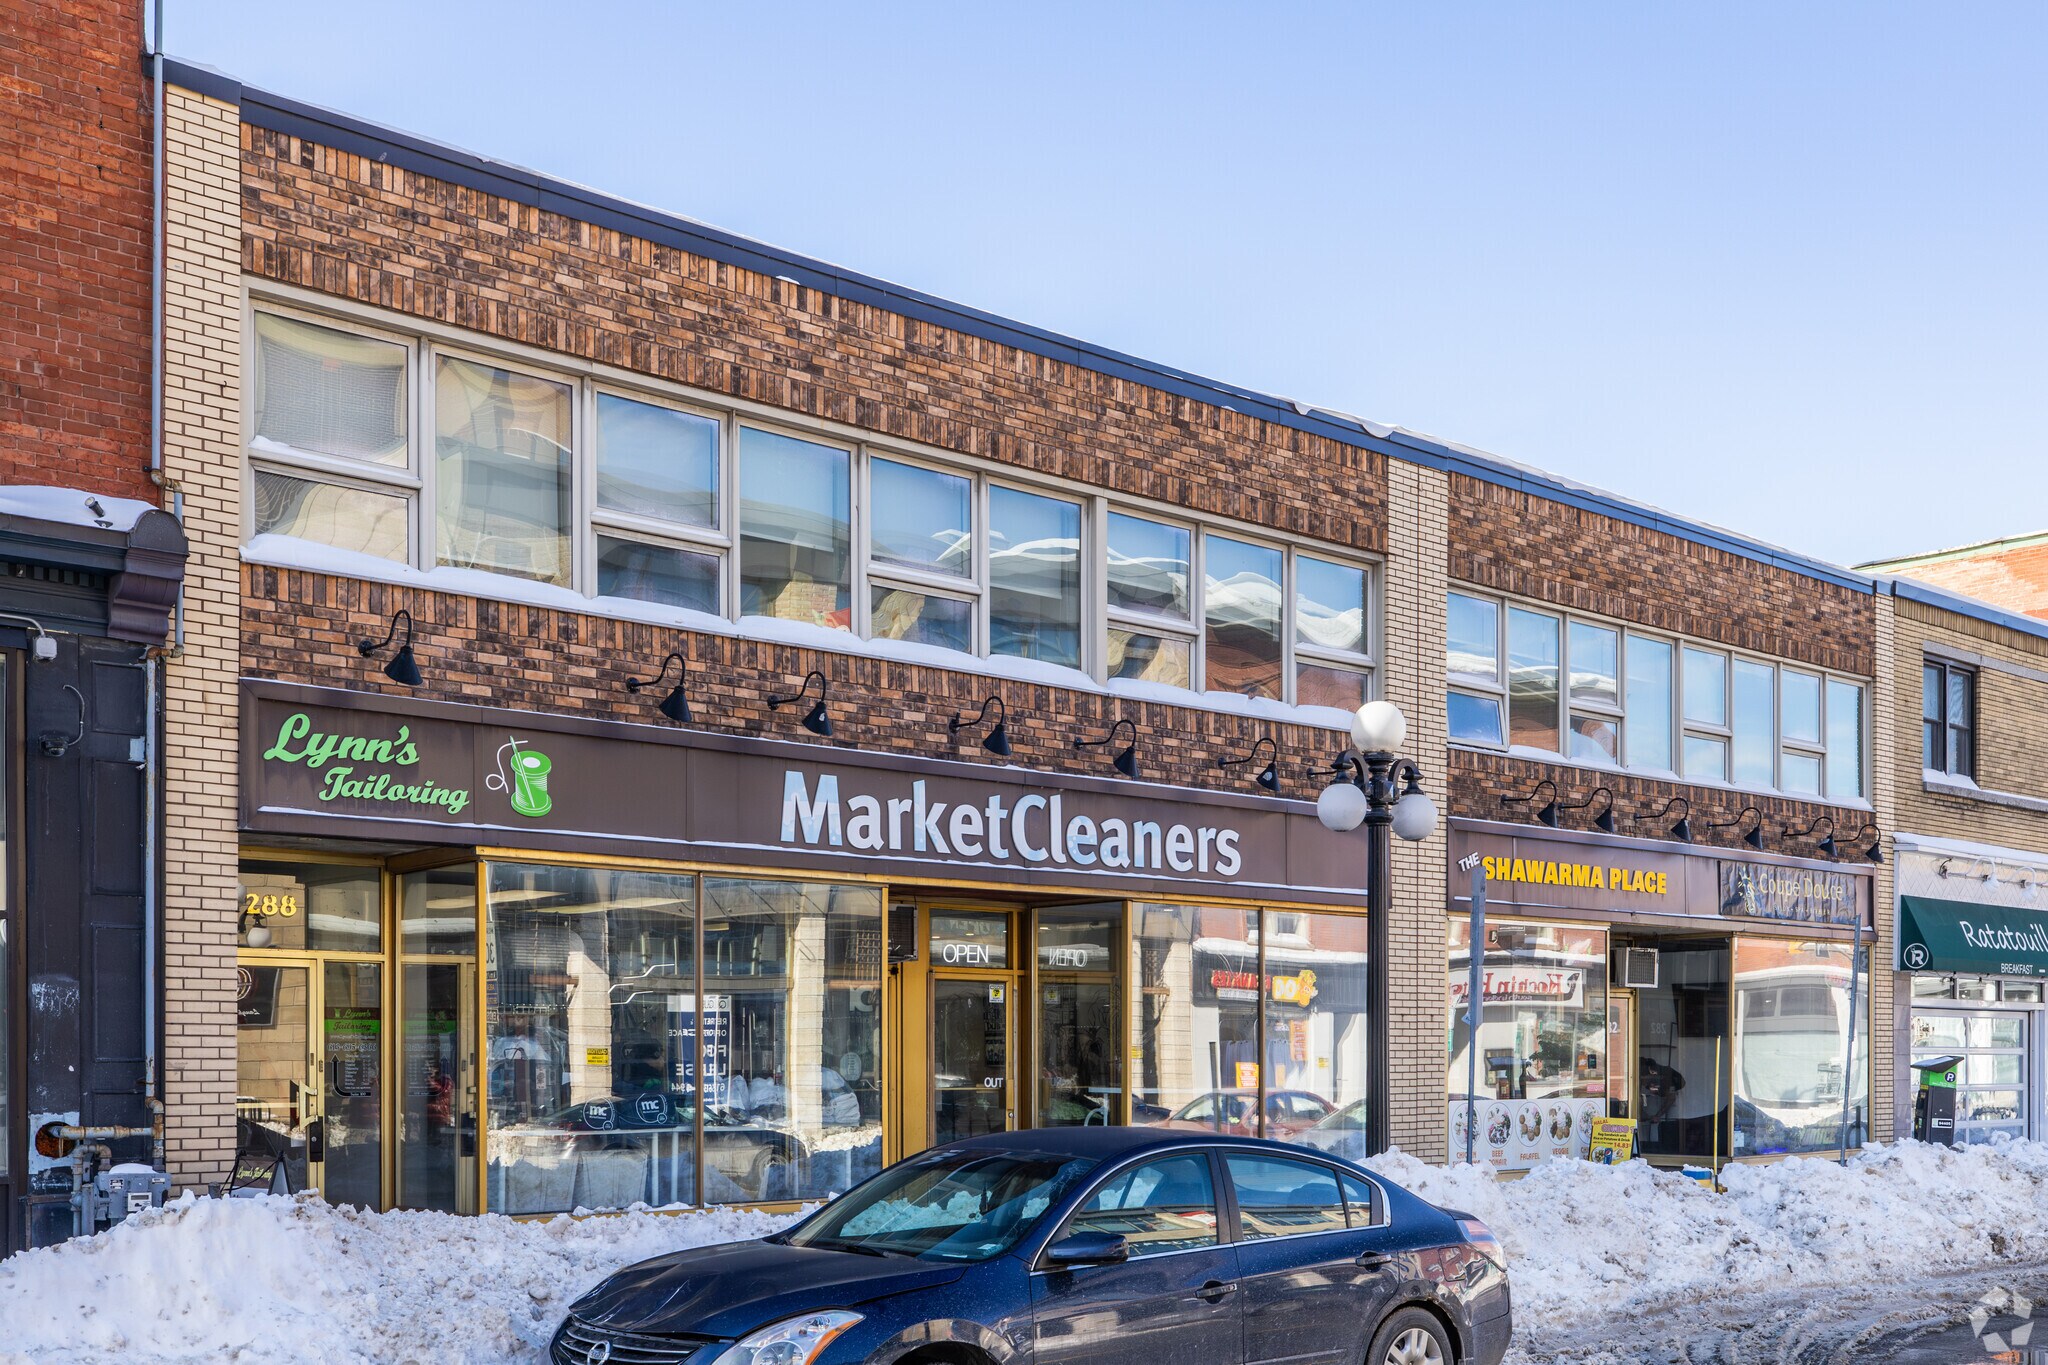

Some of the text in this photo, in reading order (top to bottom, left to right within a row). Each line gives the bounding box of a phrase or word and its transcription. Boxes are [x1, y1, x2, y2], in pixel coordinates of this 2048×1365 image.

[263, 713, 420, 768] Lynn's
[318, 767, 470, 815] Tailoring
[1458, 852, 1668, 895] THE SHAWARMA PLACE
[1759, 873, 1844, 902] Coupe Douce
[246, 893, 297, 917] 288
[943, 943, 989, 963] OPEN
[2000, 963, 2034, 975] BREAKFAST
[984, 1077, 1004, 1088] OUT
